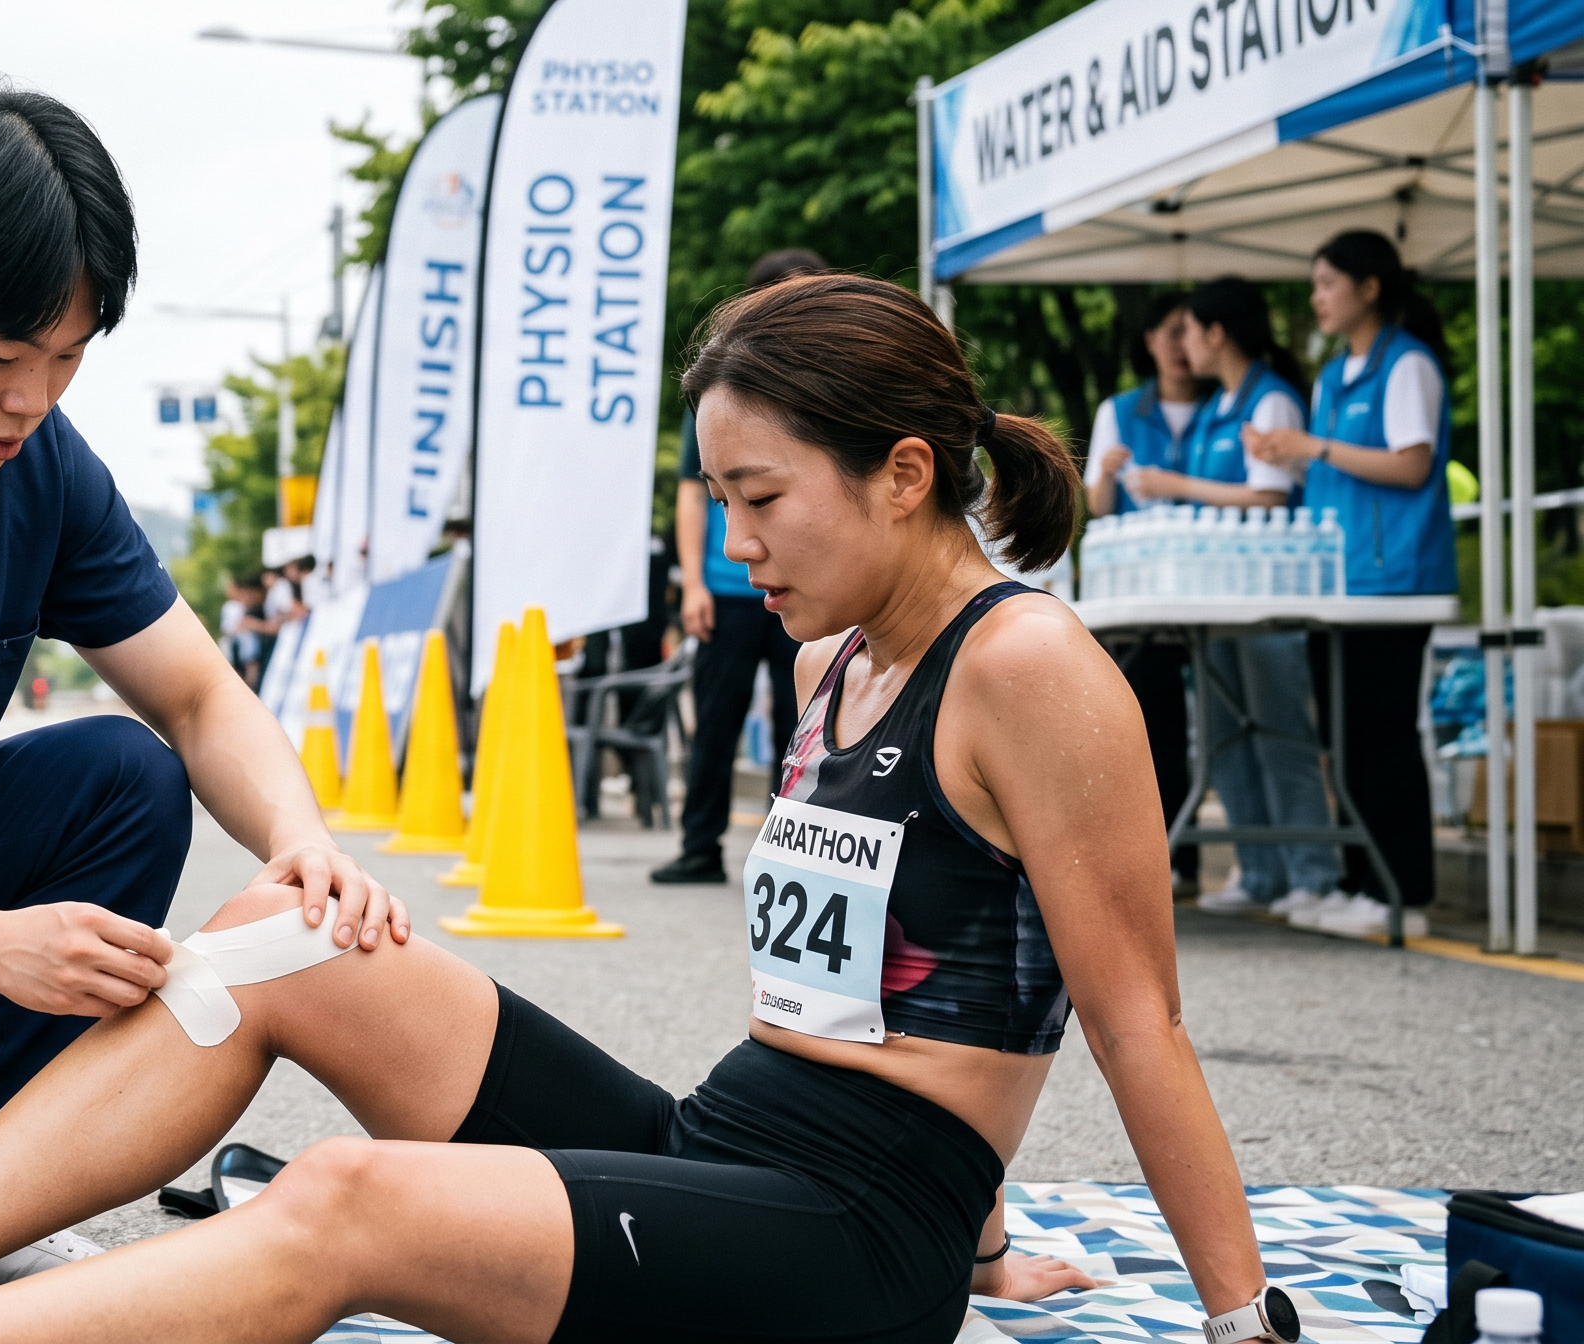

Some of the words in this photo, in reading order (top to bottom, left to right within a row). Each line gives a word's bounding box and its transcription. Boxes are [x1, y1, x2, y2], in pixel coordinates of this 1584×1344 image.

[532, 90, 659, 115] STATION
[542, 60, 655, 84] PHYSIO
[973, 75, 1077, 184] WATER
[1086, 58, 1104, 137] &
[1118, 26, 1176, 124] AID
[1191, 0, 1376, 90] STATI
[518, 174, 574, 408] PHYSIO
[590, 176, 646, 424] STATION
[761, 814, 882, 871] MARATHON
[751, 872, 853, 975] 324
